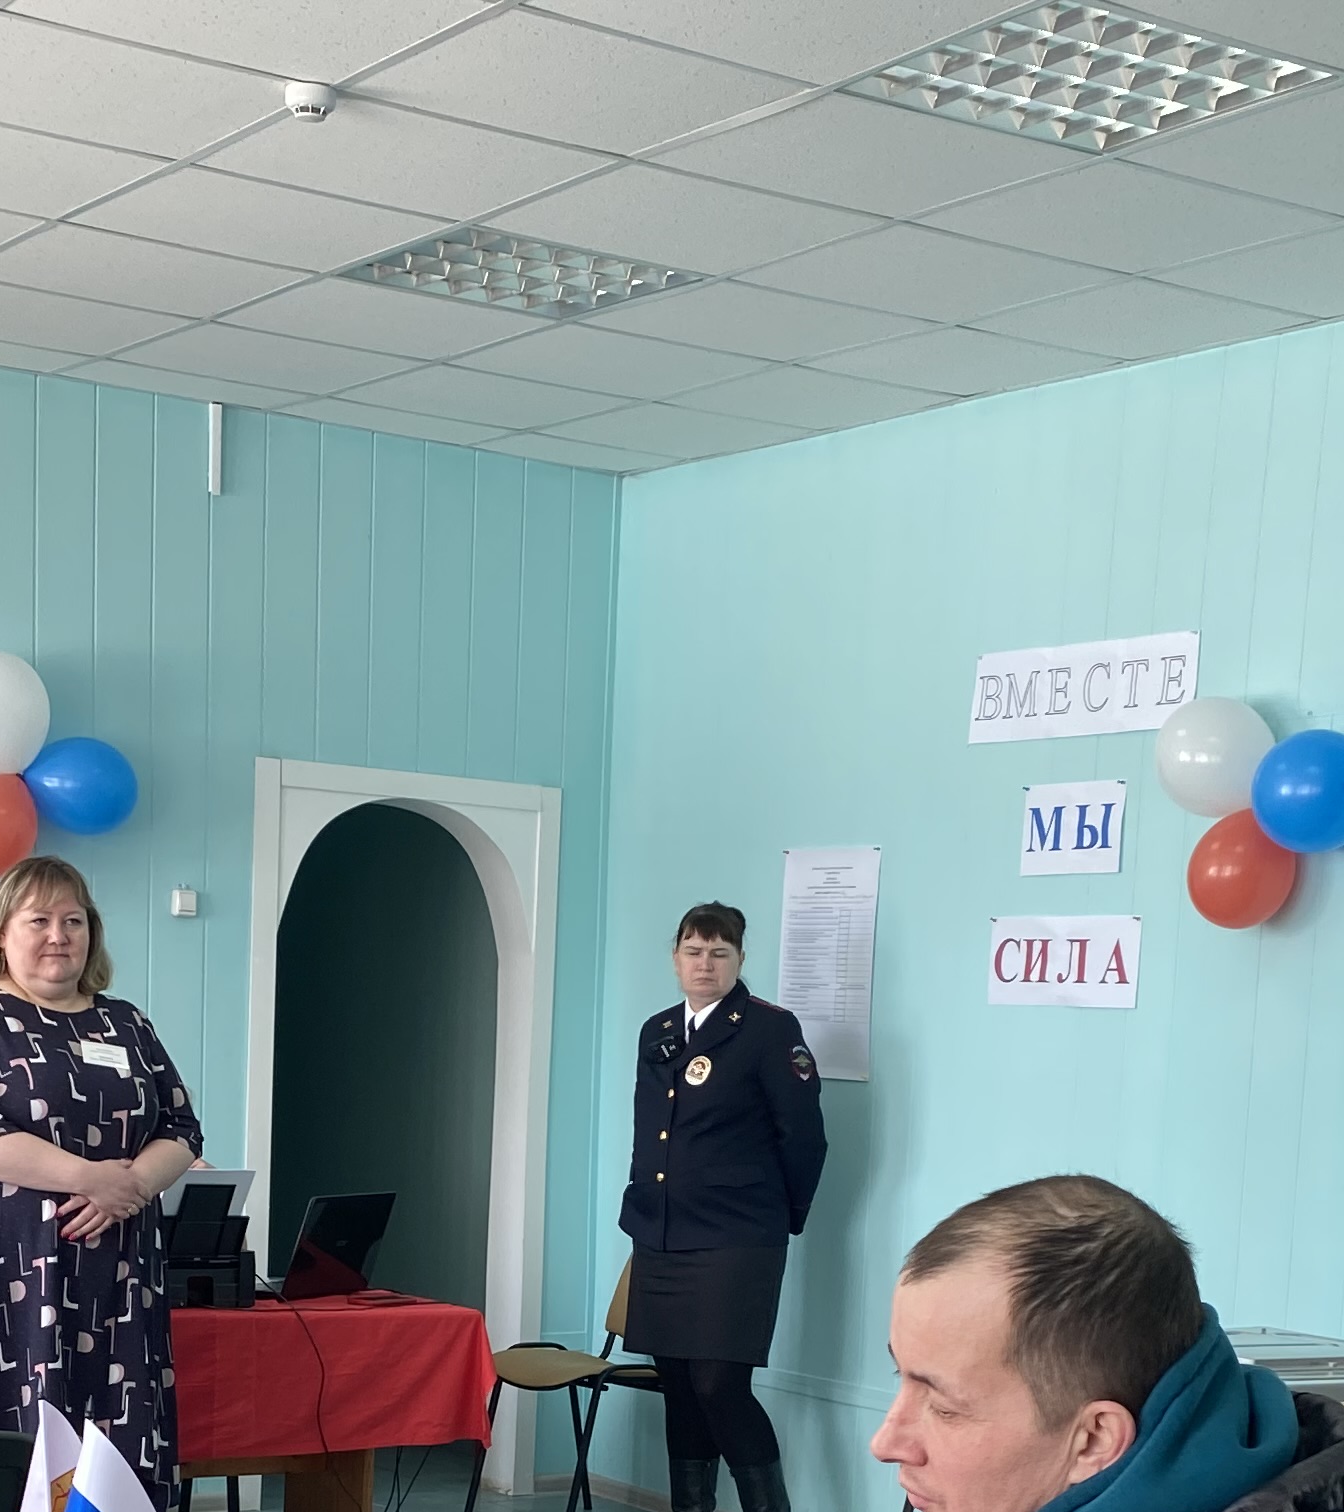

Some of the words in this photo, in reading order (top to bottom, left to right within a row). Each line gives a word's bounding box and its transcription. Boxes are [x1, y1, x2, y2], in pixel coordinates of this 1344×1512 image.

[974, 653, 1188, 724] ВМЕСТЕ
[1025, 800, 1116, 853] МЫ
[993, 935, 1132, 986] СИЛА
